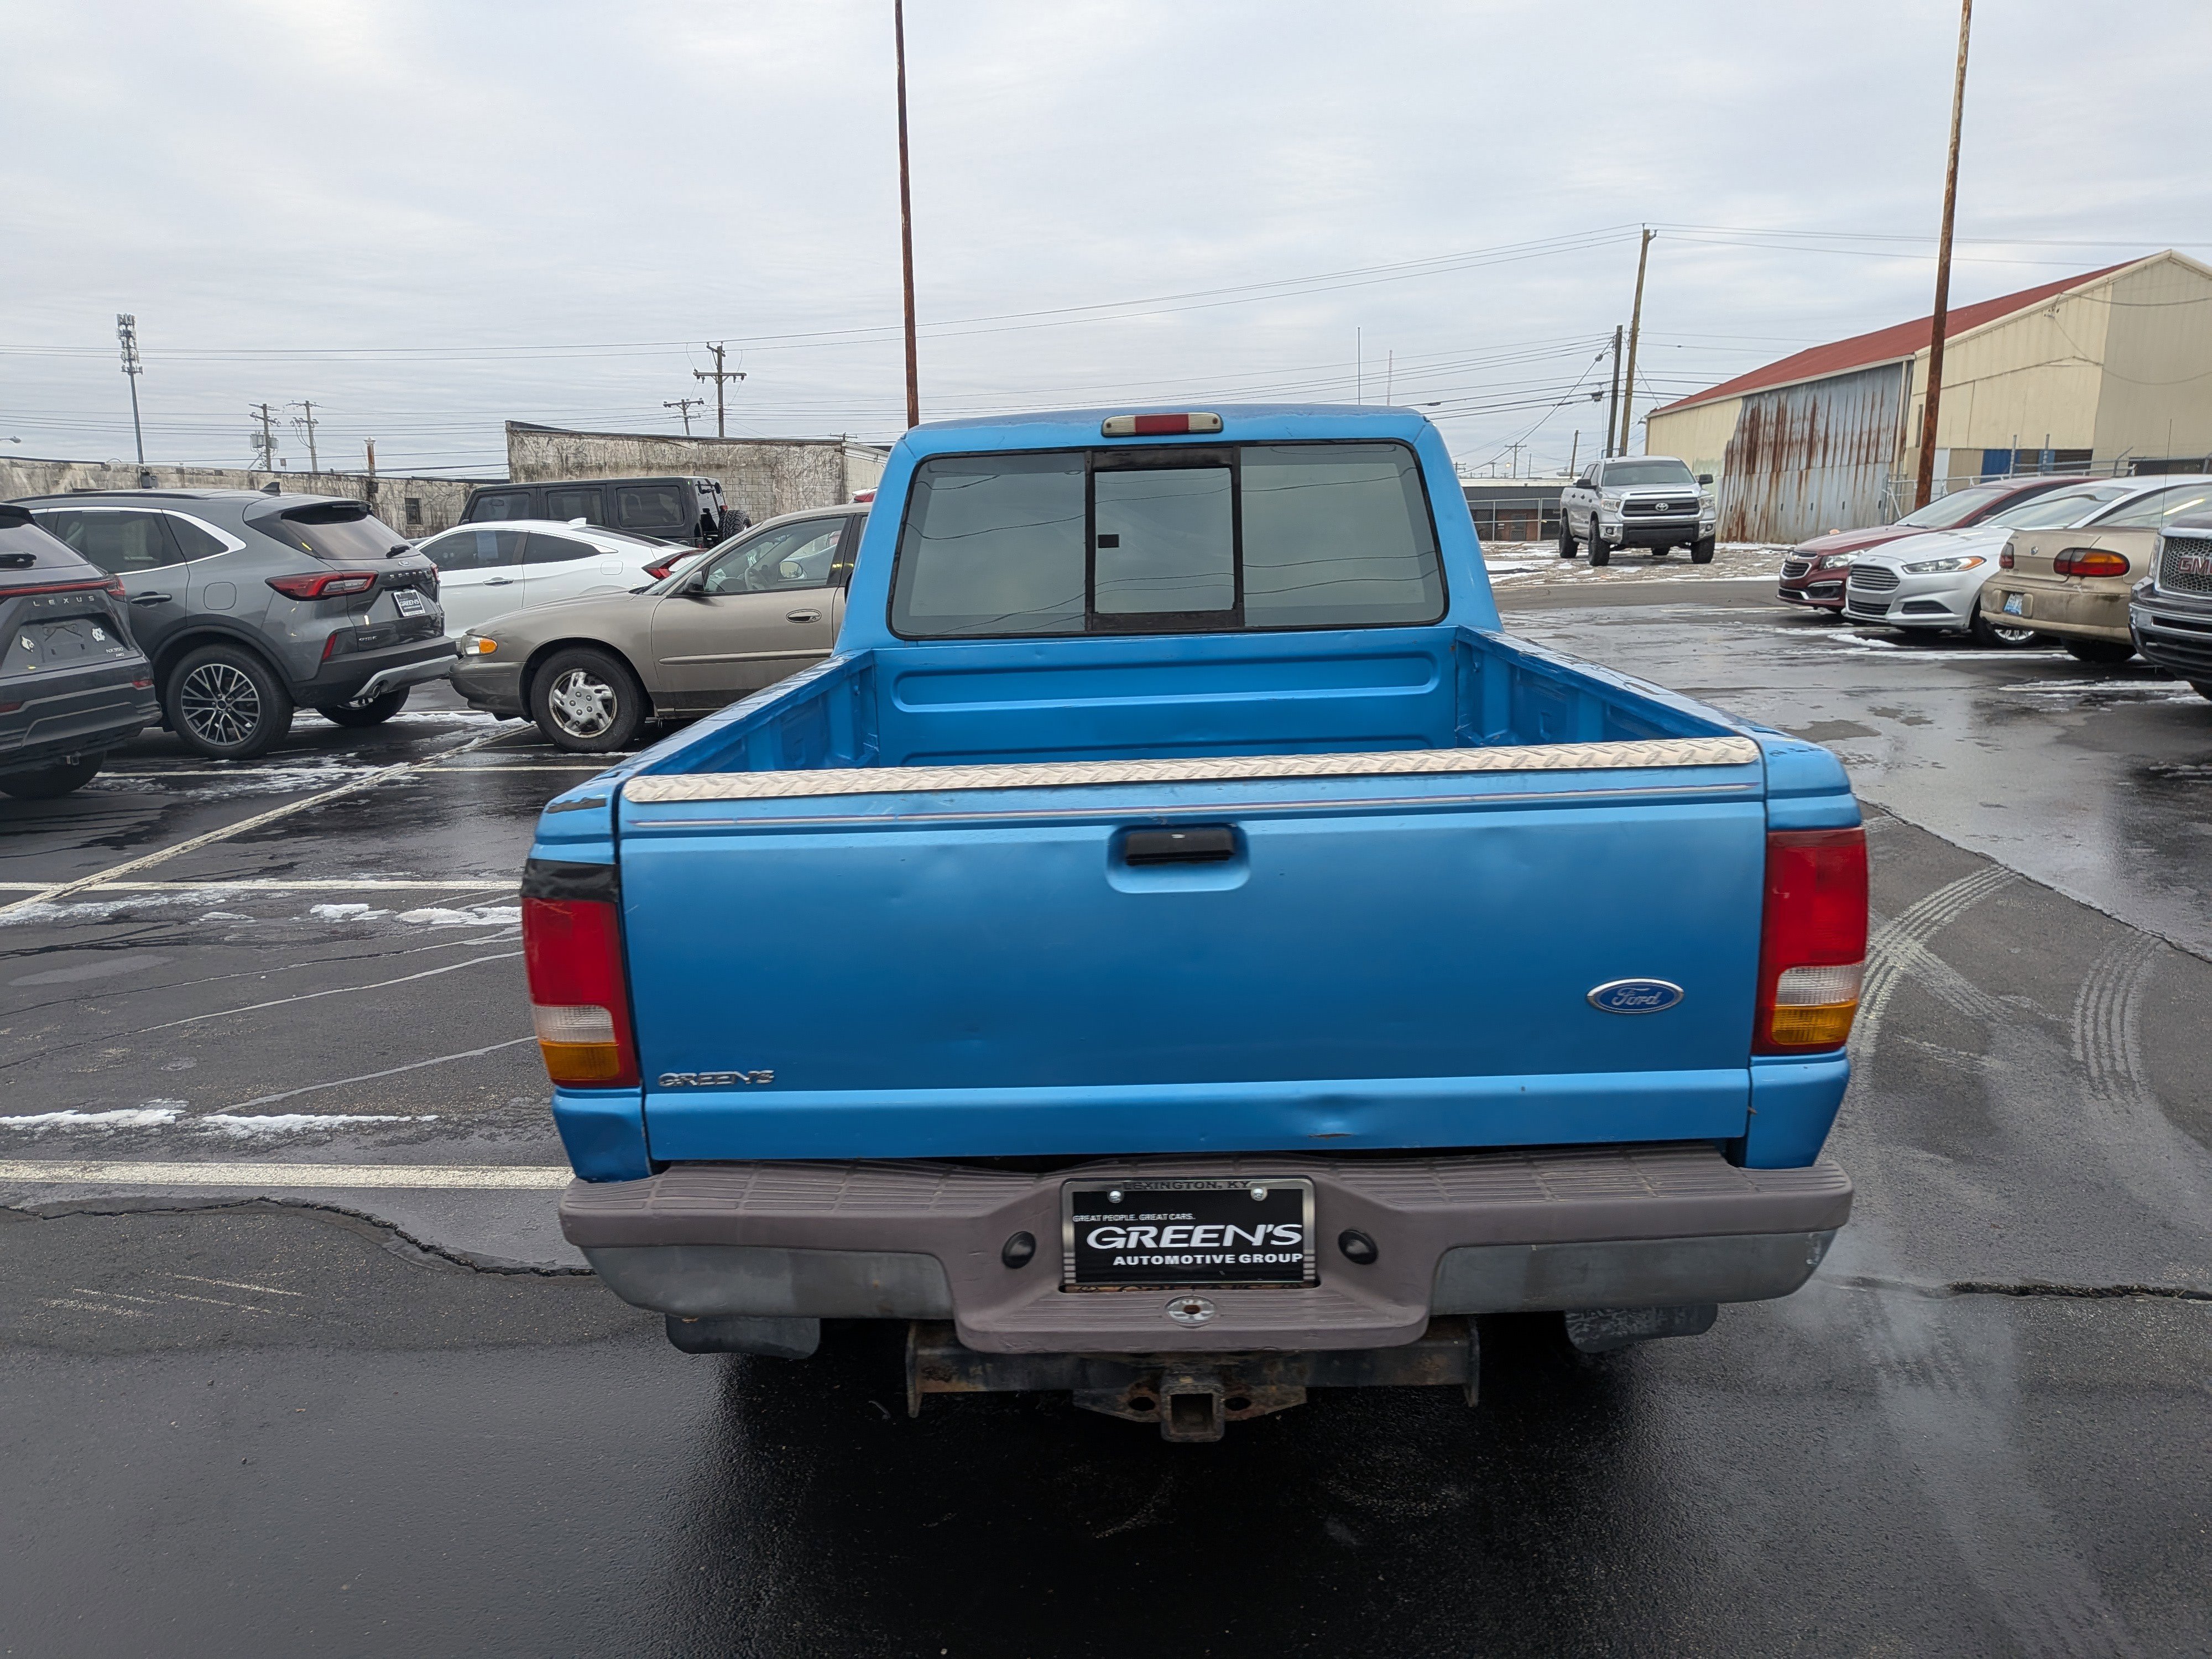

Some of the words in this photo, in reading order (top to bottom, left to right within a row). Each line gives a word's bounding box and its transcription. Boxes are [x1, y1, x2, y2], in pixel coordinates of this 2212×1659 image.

[2178, 556, 2212, 575] GM
[33, 596, 95, 607] LEXUS
[1611, 987, 1662, 1006] Ford
[1086, 1224, 1303, 1249] GREEN'S
[1113, 1254, 1236, 1266] AUTOMOTIVE
[1238, 1253, 1304, 1264] GROUP
